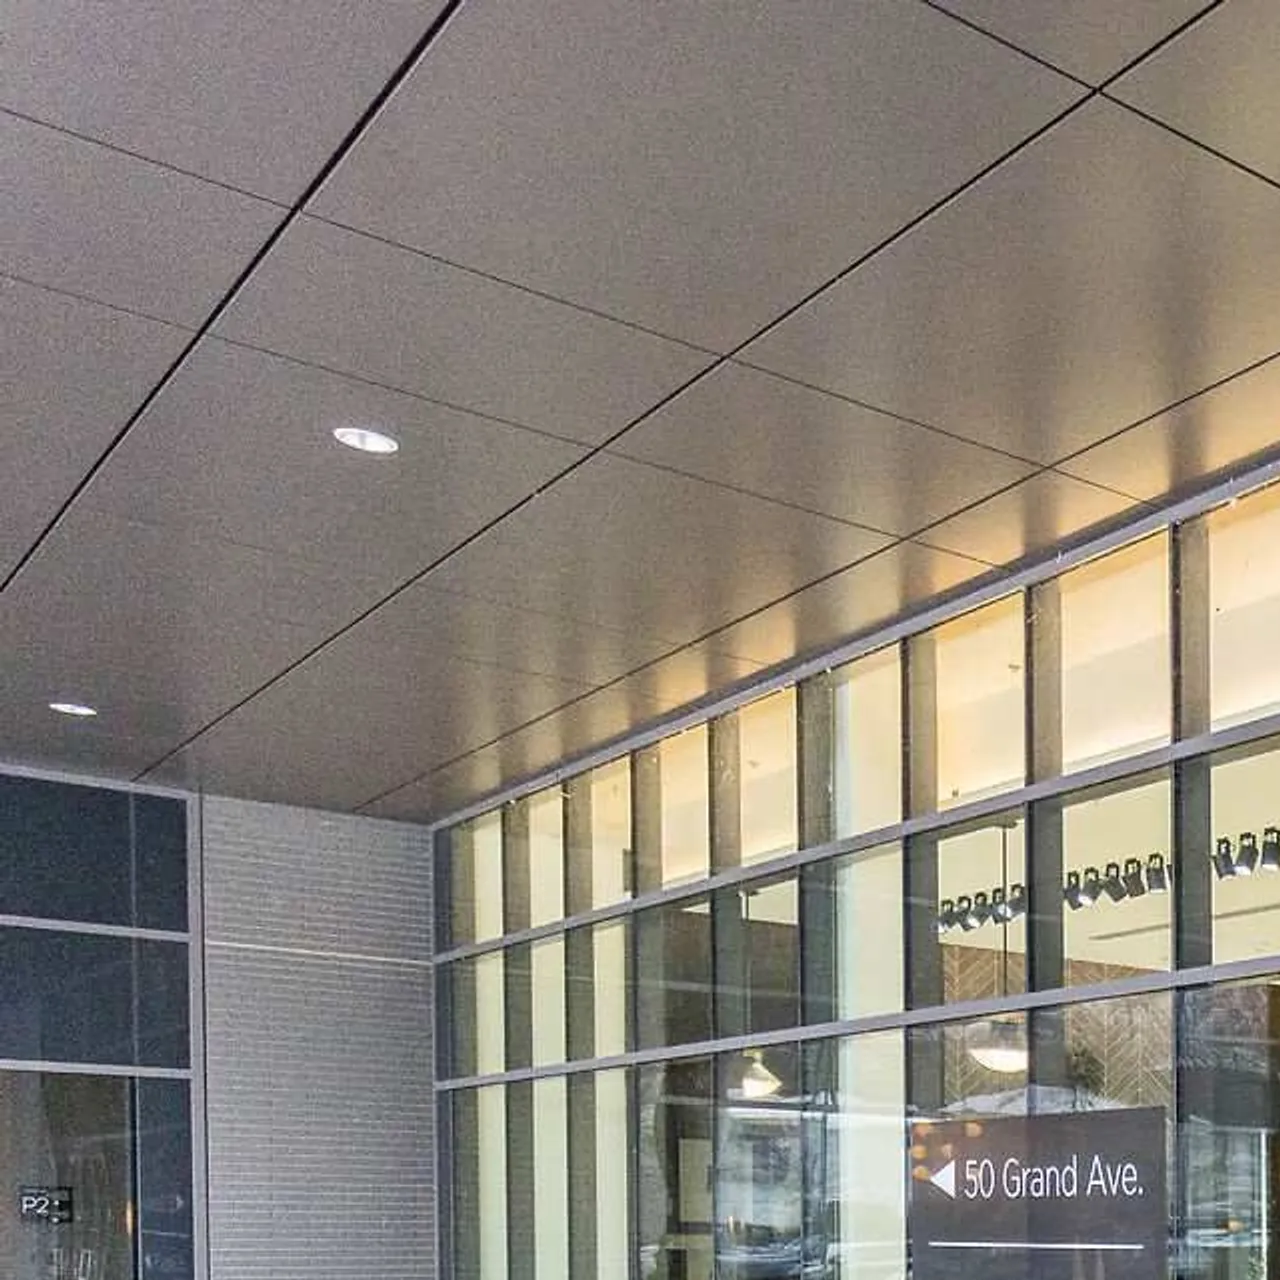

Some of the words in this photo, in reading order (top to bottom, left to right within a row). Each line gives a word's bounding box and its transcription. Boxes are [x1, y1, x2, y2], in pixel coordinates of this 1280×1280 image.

[964, 1159, 996, 1199] 50
[1002, 1155, 1078, 1199] Grand
[1086, 1155, 1144, 1197] Ave.
[21, 1195, 50, 1214] P2
